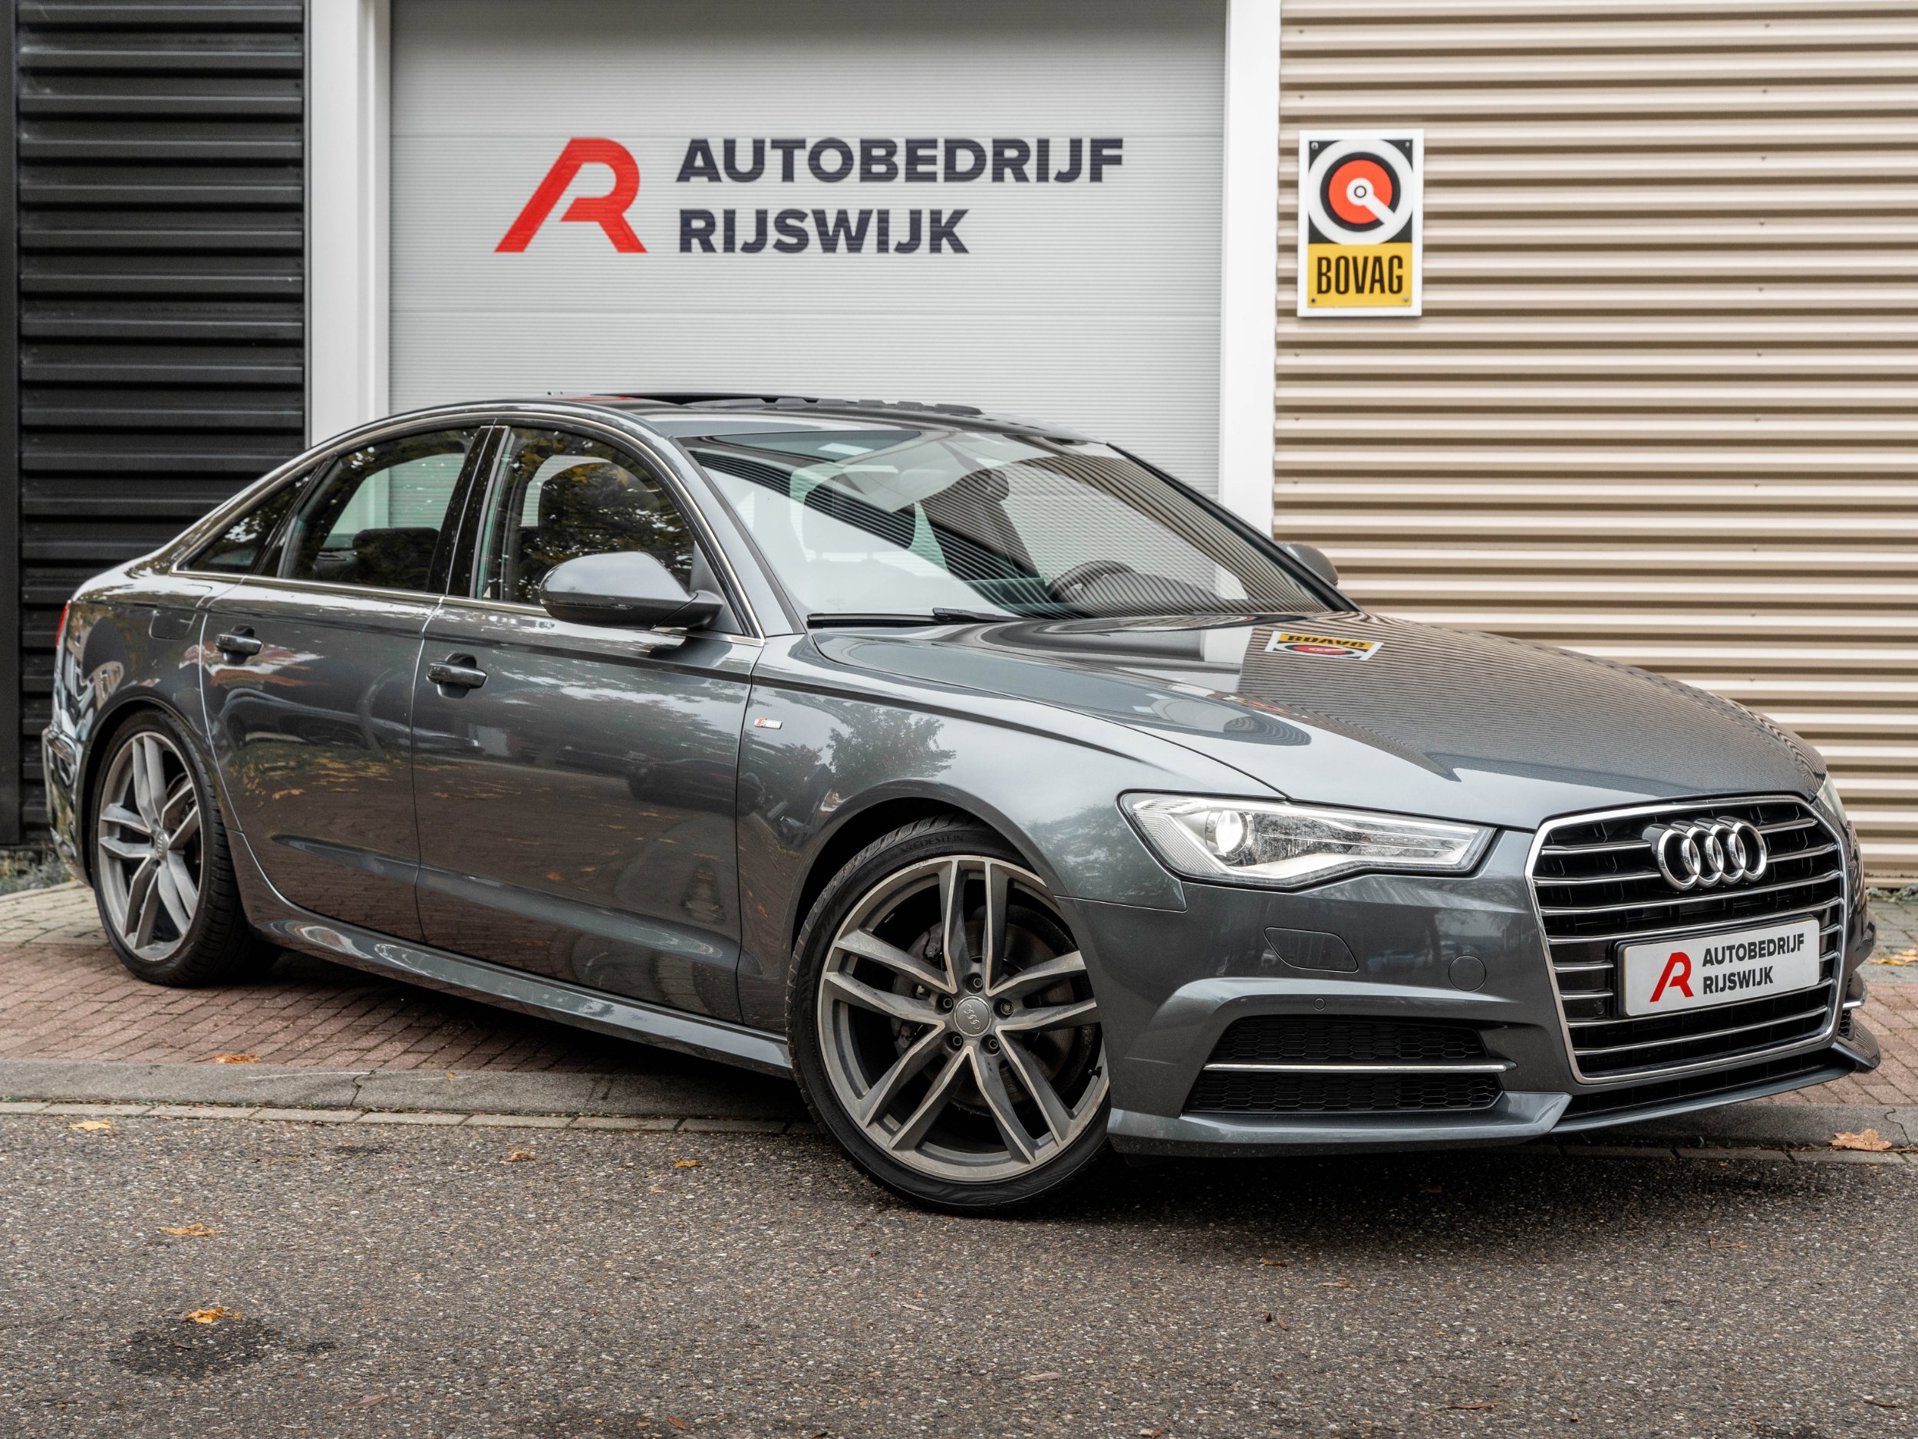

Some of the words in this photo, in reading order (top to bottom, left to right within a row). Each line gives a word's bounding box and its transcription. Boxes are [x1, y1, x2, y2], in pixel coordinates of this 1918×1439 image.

[676, 137, 1124, 183] AUTOBEDRIJF
[679, 208, 970, 254] RIJSWIJK
[1317, 255, 1404, 295] BOVAG
[1702, 933, 1804, 967] AUTOBEDRIJF
[1703, 966, 1774, 995] RIJSWIJK
